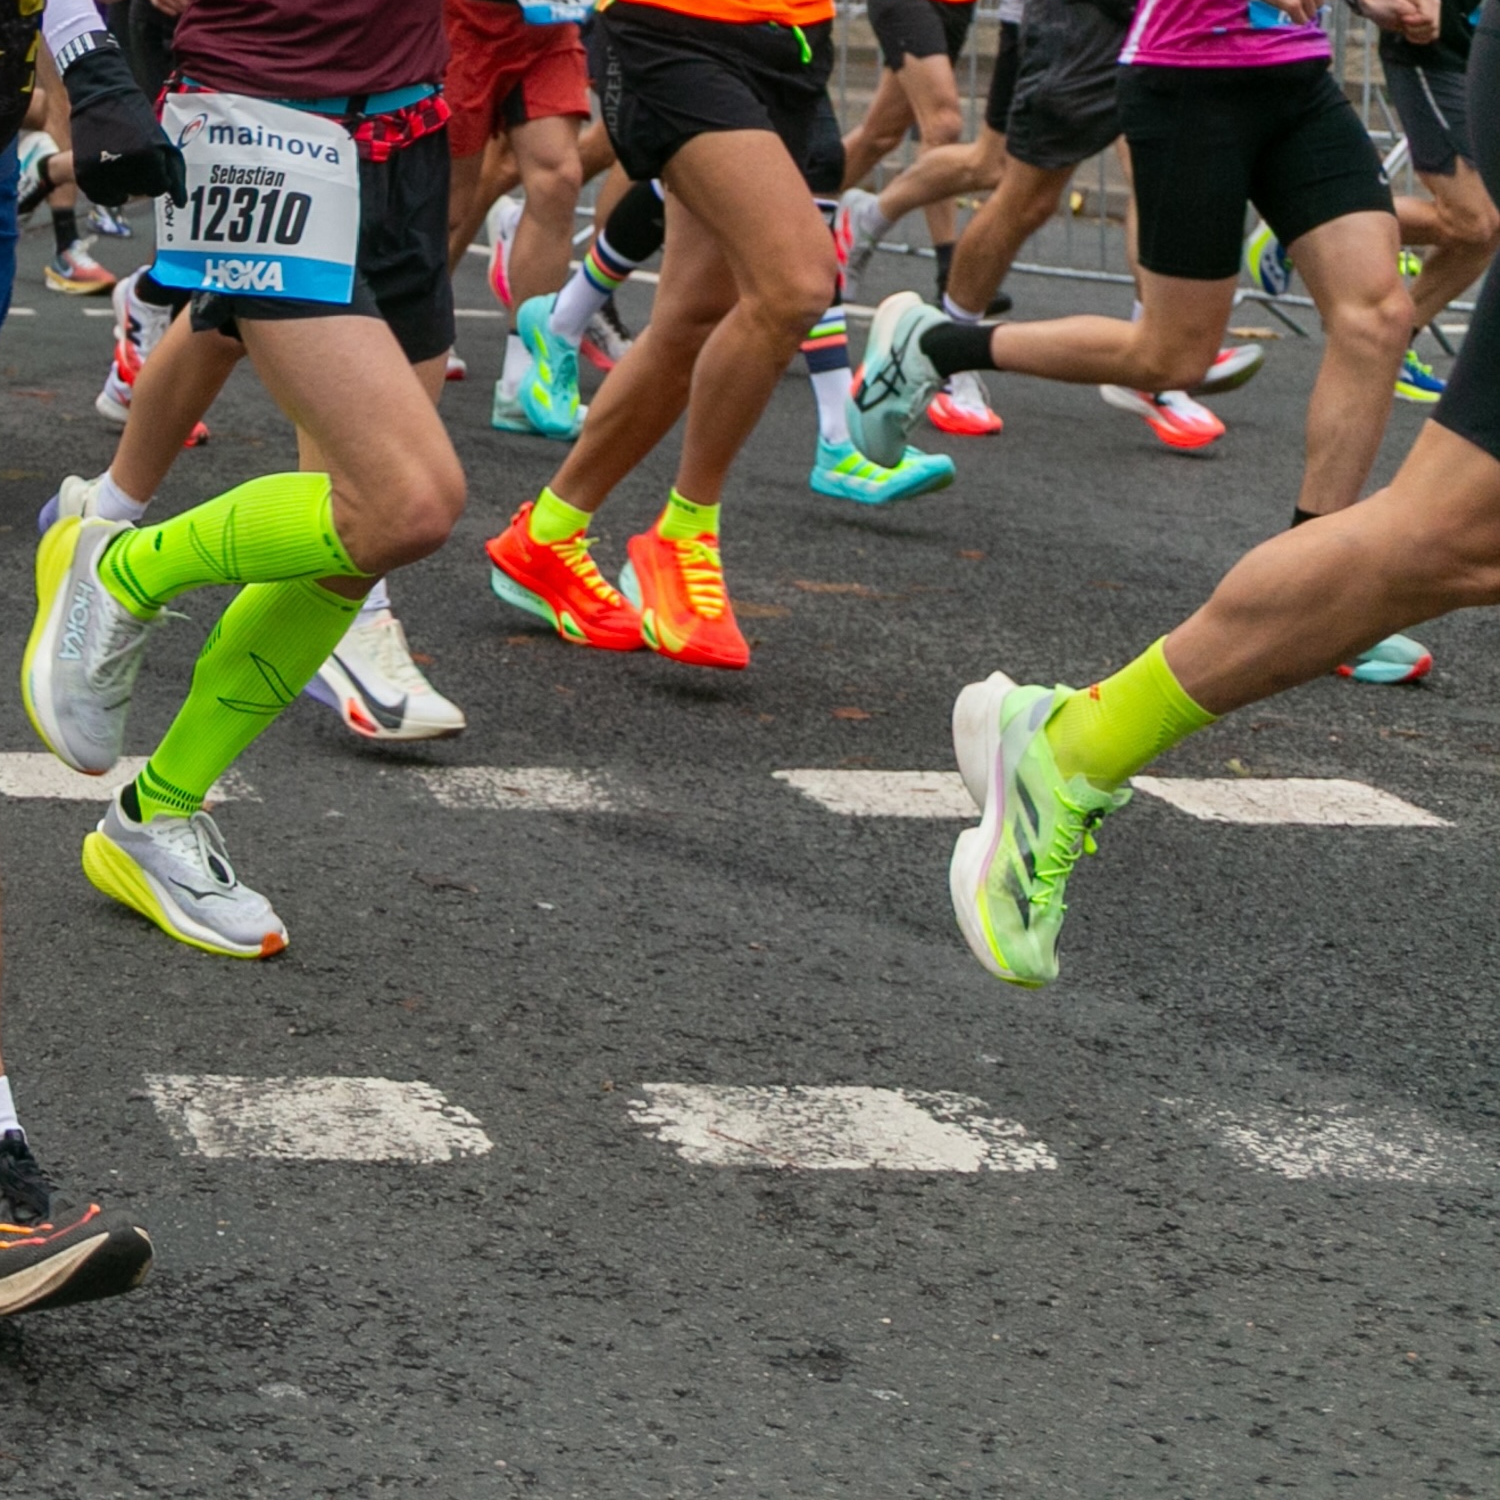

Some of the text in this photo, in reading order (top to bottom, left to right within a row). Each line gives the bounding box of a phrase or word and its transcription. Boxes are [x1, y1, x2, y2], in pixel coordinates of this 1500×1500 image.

[208, 124, 341, 165] mainova
[210, 164, 286, 188] Sebastian
[190, 186, 313, 245] 12310
[201, 258, 285, 292] HOKA
[57, 580, 95, 661] HOKA
